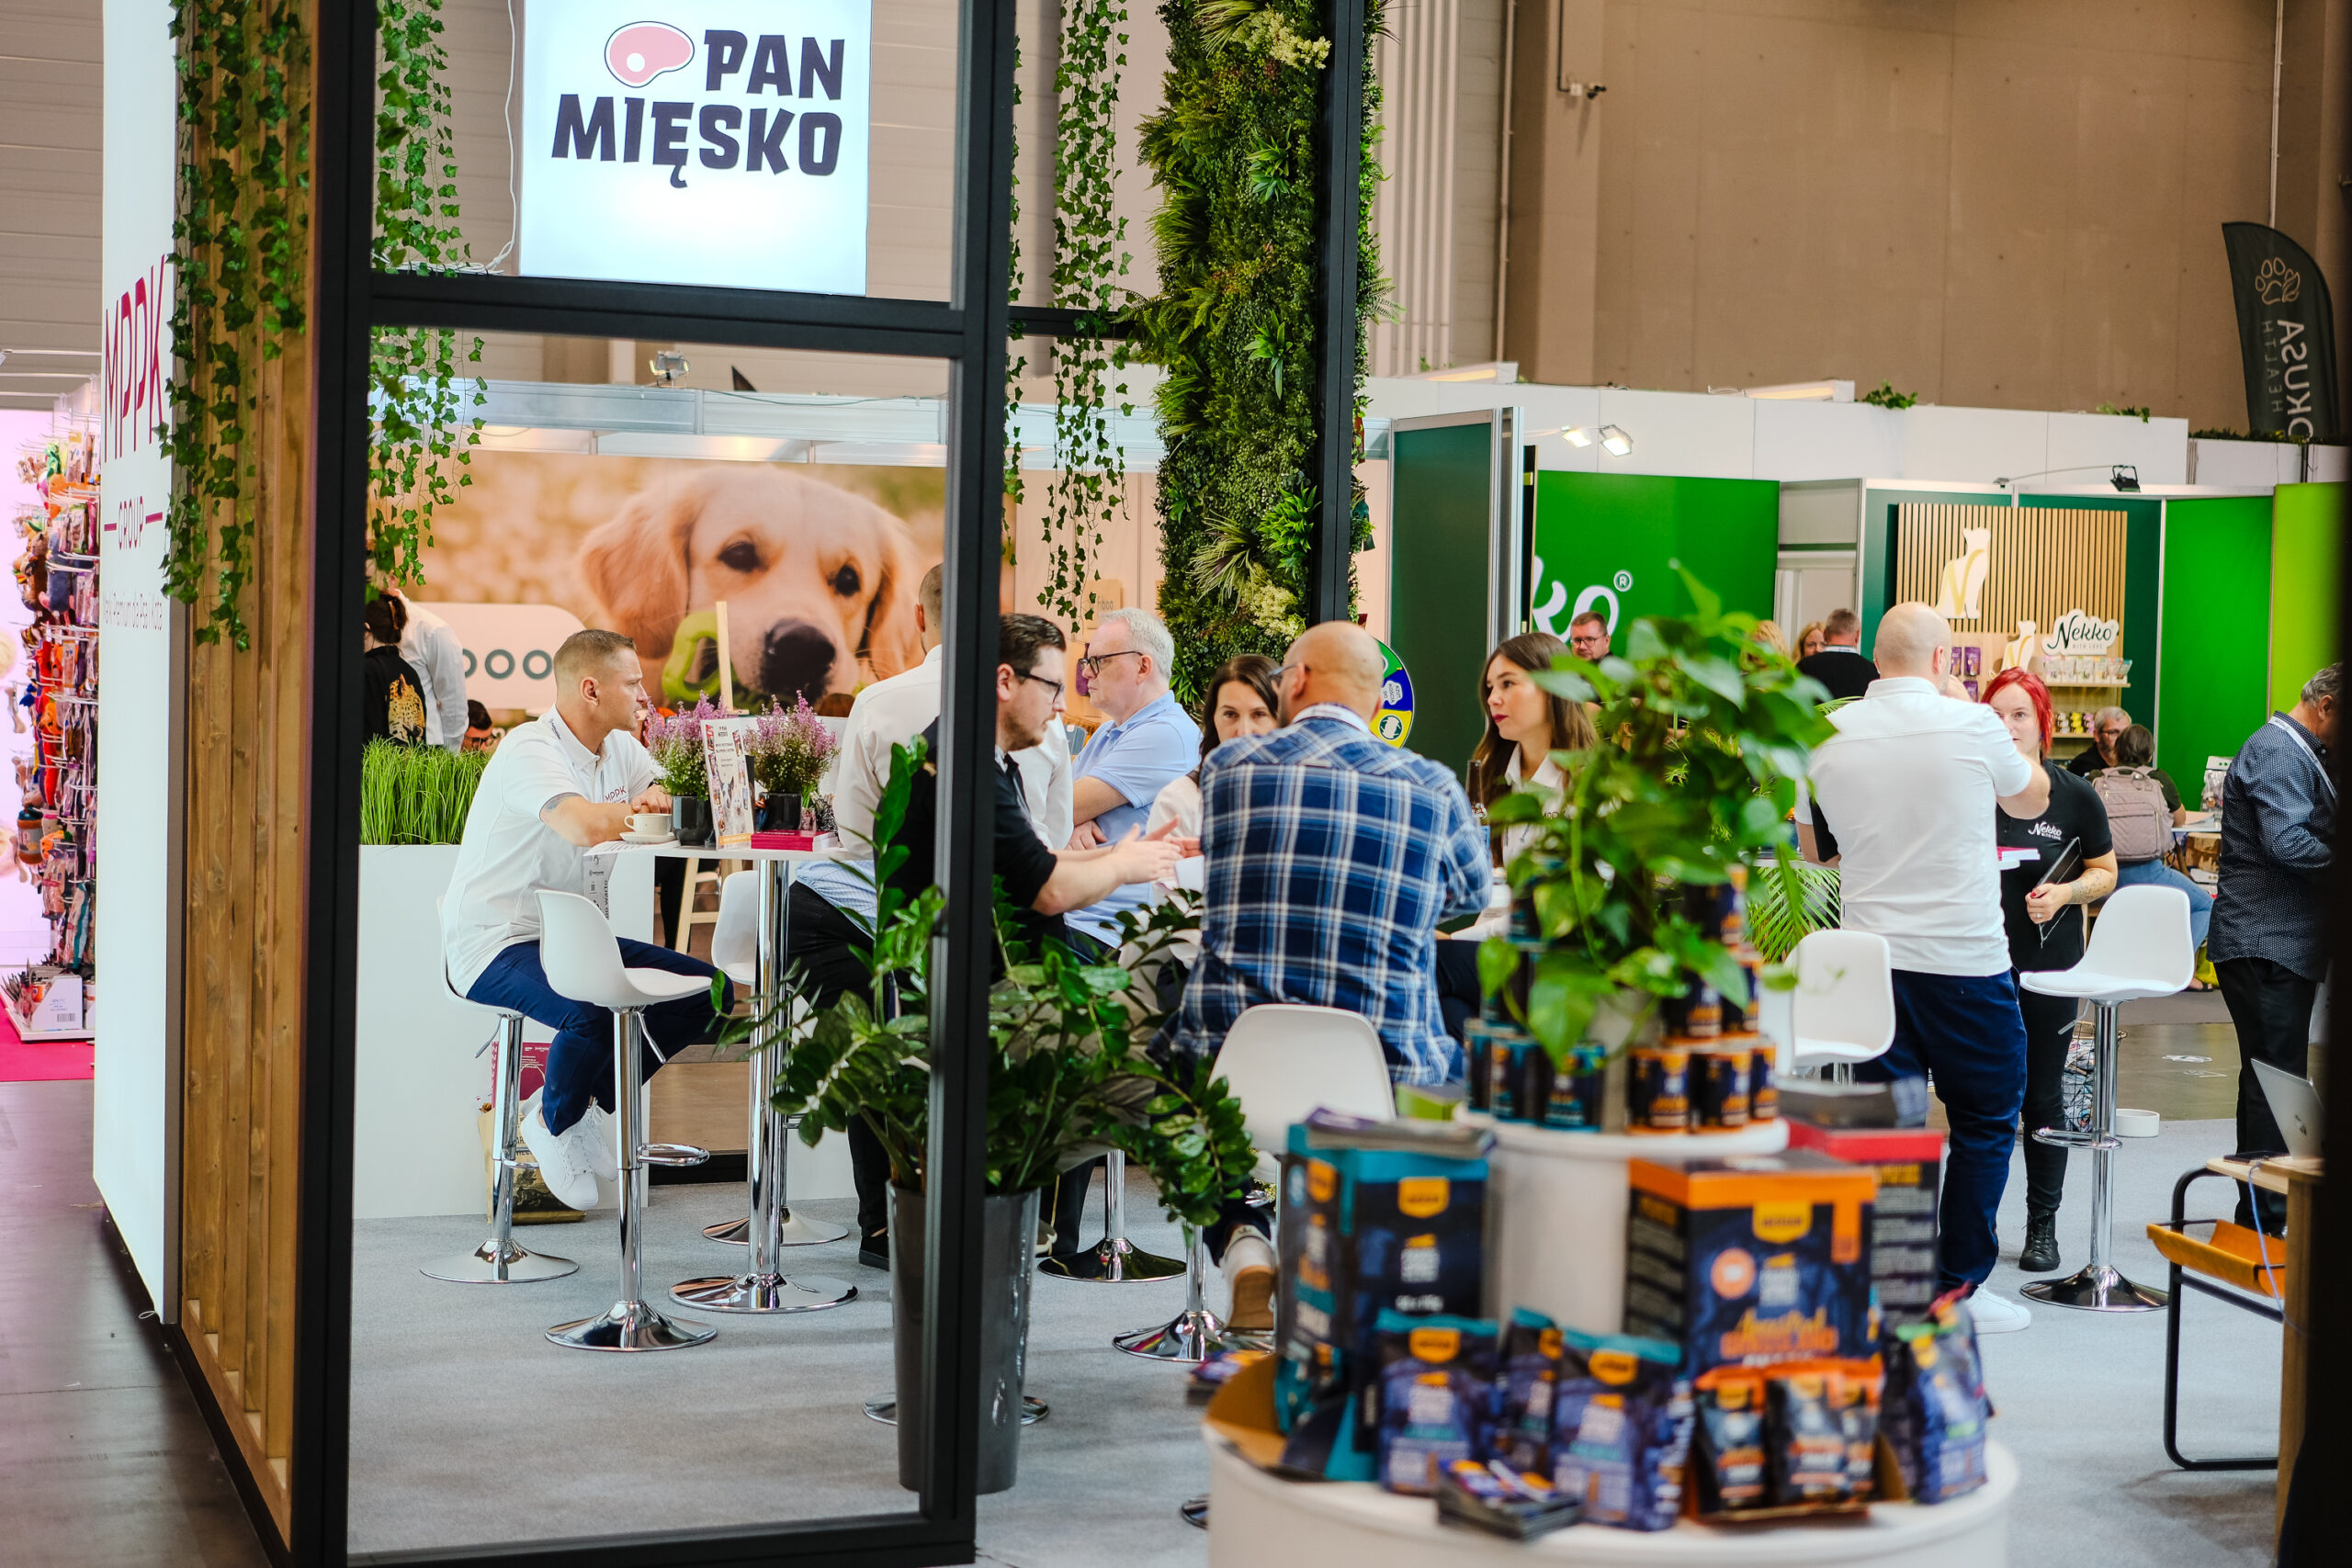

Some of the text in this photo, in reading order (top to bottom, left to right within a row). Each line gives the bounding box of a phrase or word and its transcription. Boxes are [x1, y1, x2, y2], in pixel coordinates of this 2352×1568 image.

[704, 29, 845, 100] PAN
[552, 94, 842, 188] MIĘSKO
[105, 254, 165, 462] MPPK
[119, 496, 143, 549] GROUP
[2047, 615, 2112, 649] Nekko
[605, 785, 627, 801] MPPK
[2028, 822, 2063, 836] Nekko
